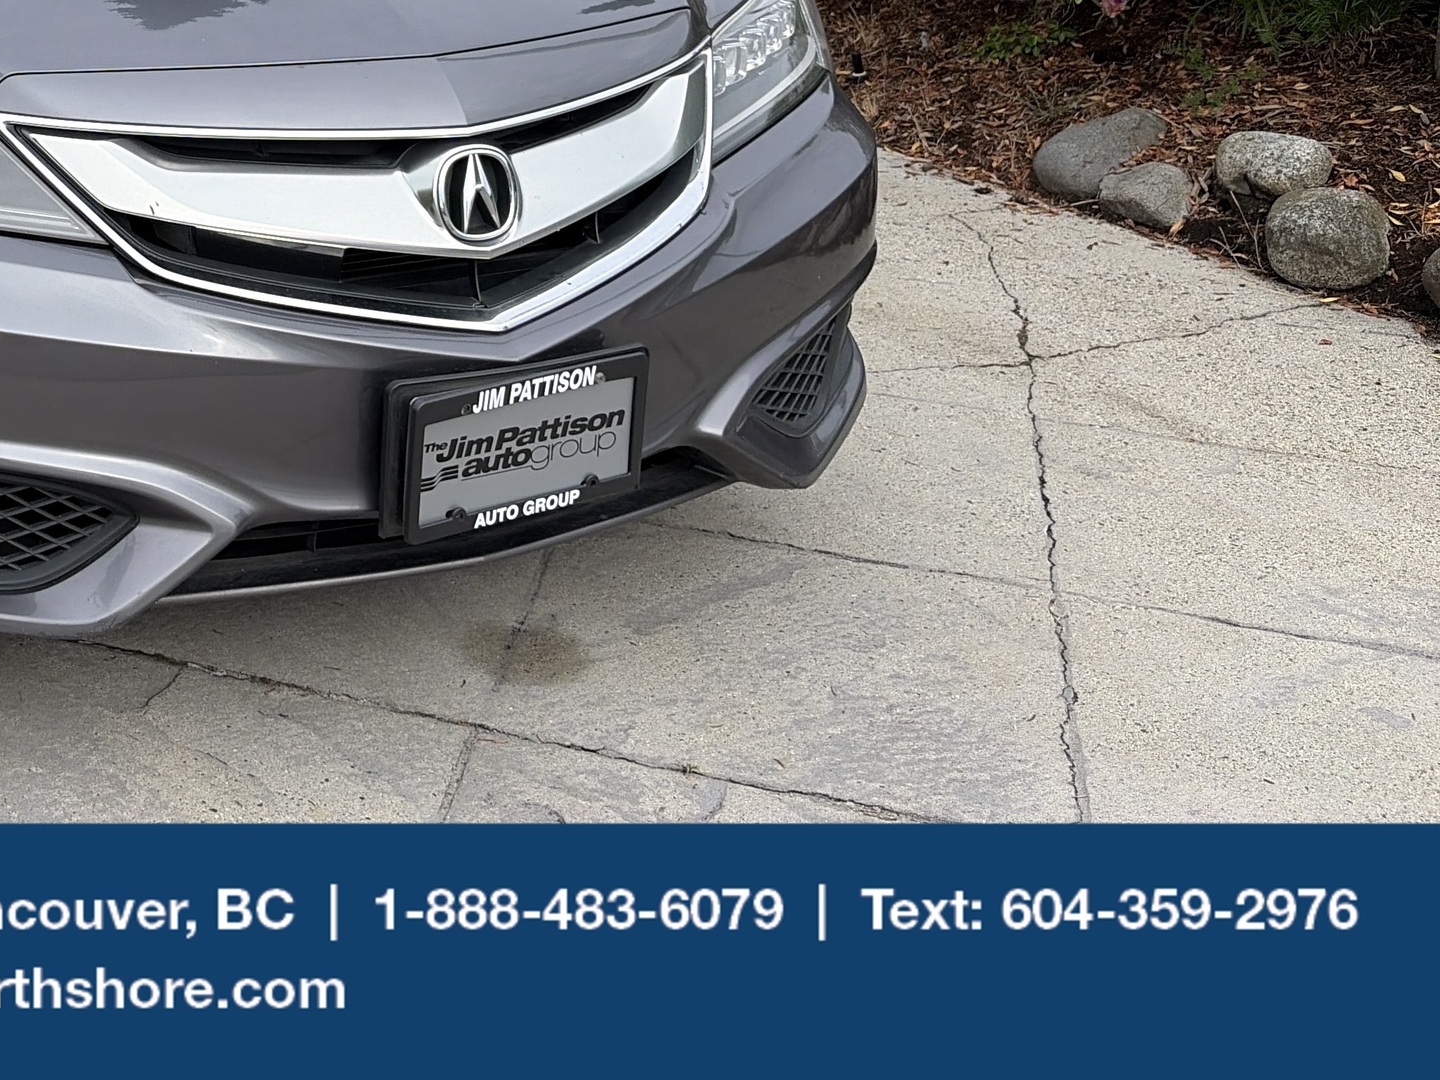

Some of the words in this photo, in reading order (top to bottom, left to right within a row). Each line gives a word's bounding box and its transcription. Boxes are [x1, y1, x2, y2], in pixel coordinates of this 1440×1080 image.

[472, 386, 506, 414] JIM
[509, 365, 597, 405] PATTISON
[424, 441, 448, 454] The
[436, 434, 494, 463] Jim
[495, 408, 626, 451] Pattison
[473, 502, 519, 529] AUTO
[522, 489, 580, 517] GROUP
